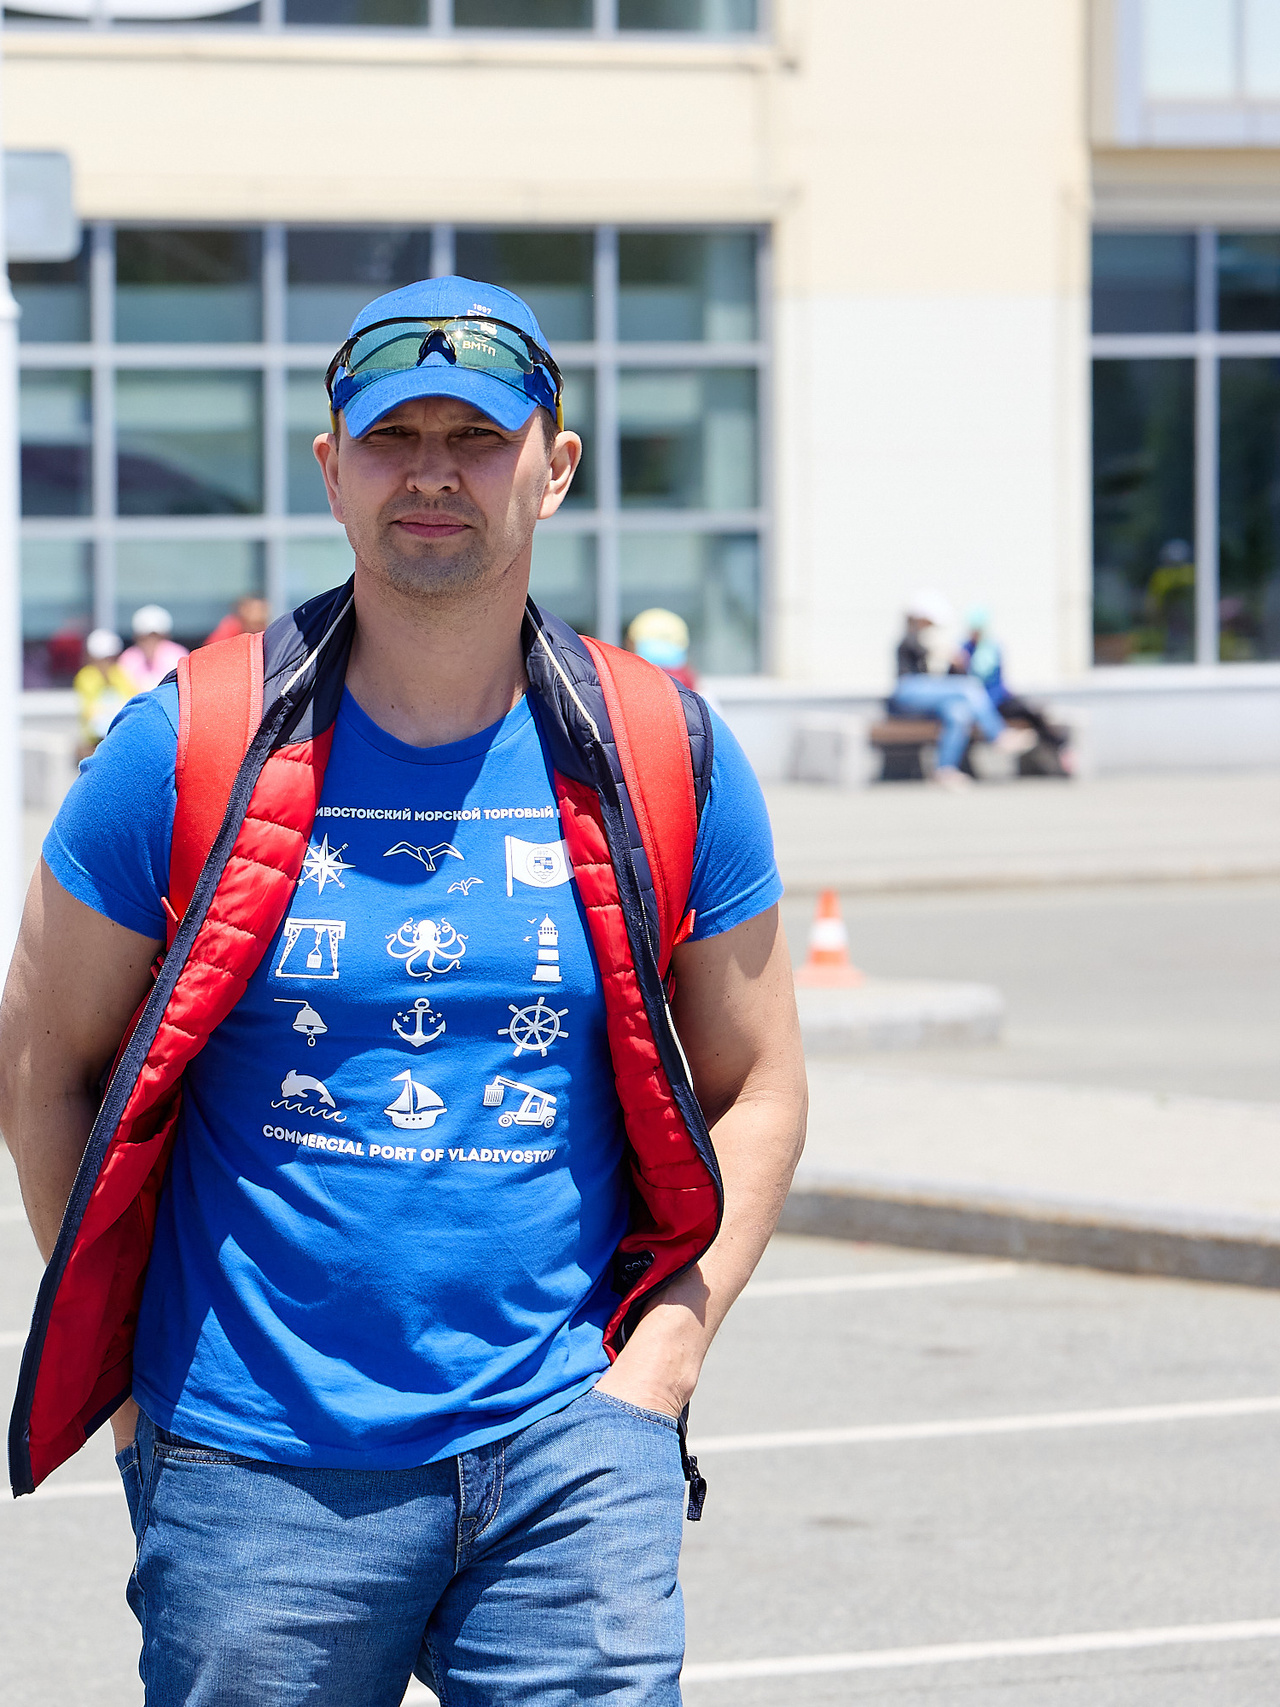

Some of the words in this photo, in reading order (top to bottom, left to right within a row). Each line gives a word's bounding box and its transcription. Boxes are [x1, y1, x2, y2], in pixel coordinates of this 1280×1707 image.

[414, 808, 481, 821] МОРСКОЙ
[484, 806, 554, 819] ТОРГОВЫЙ
[262, 1124, 364, 1156] COMMERCIAL
[369, 1145, 416, 1161] PORT
[421, 1149, 445, 1162] OF
[448, 1149, 557, 1164] VLADIVOSTOK
